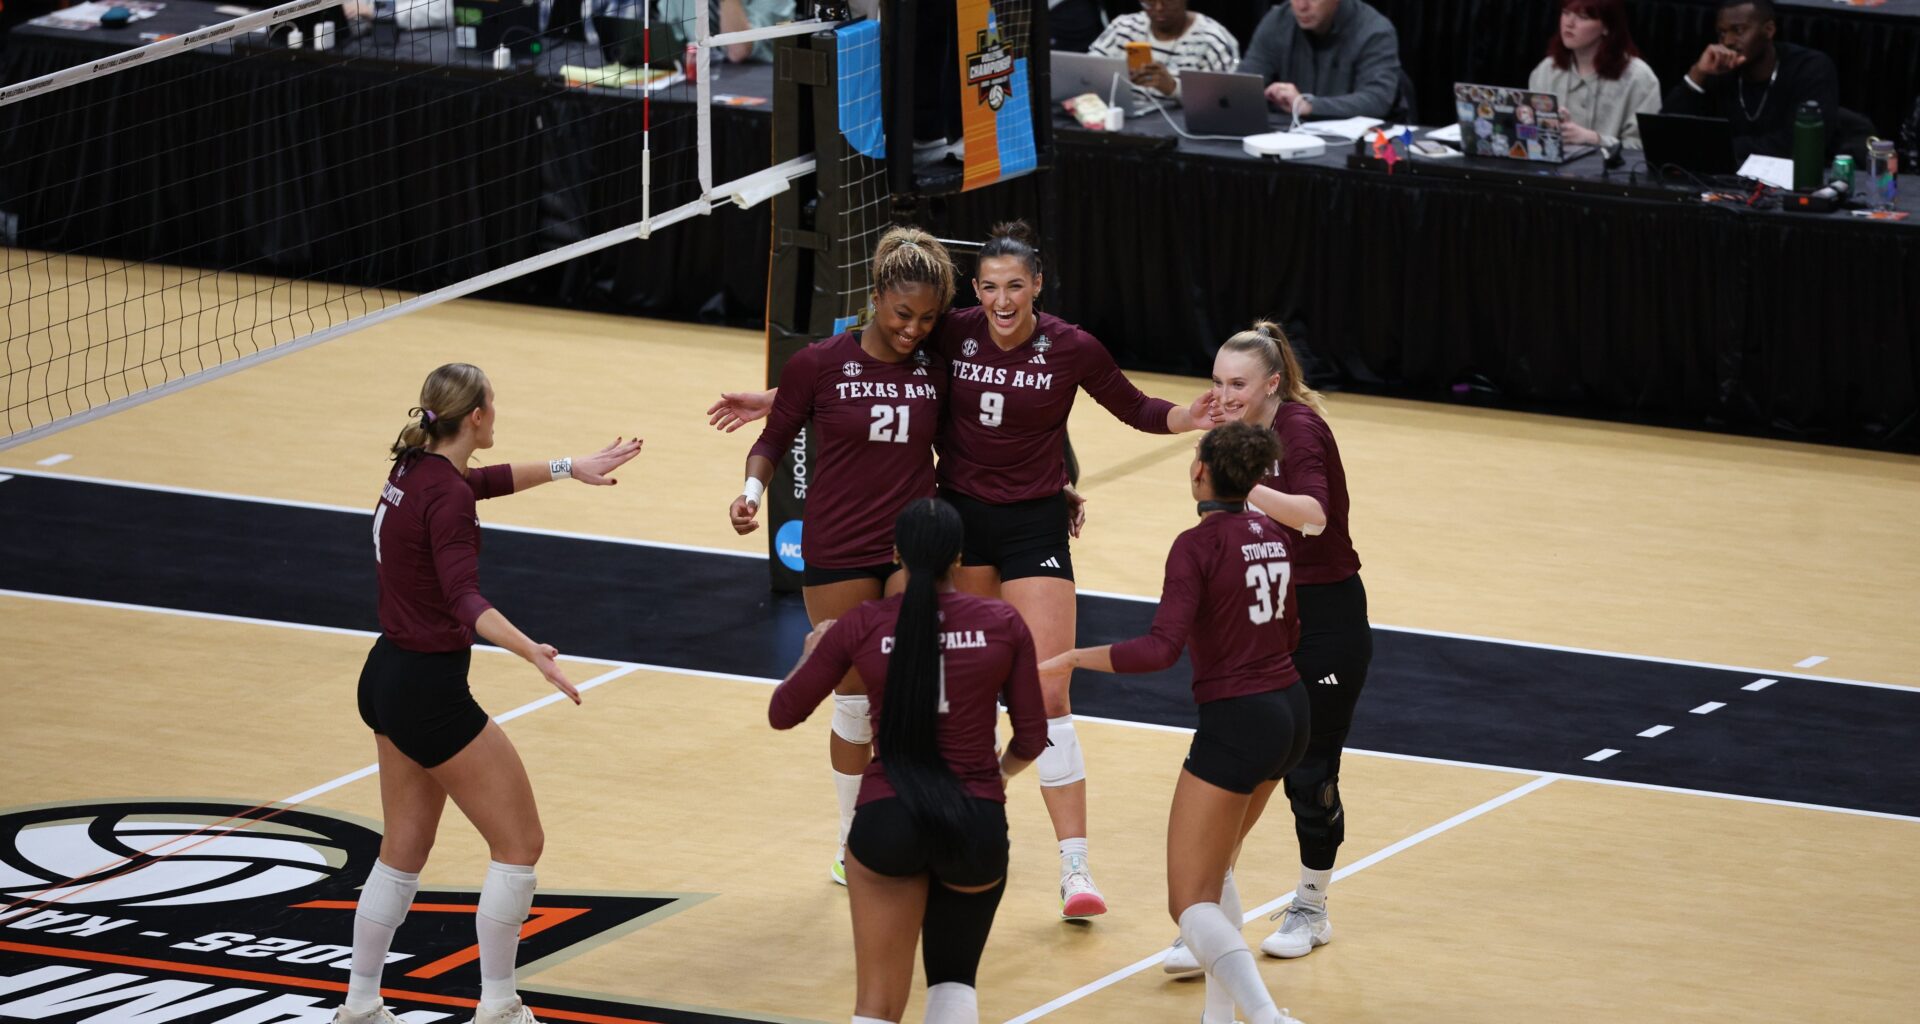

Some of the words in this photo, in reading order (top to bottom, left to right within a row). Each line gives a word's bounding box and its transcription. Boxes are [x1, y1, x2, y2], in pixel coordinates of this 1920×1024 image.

[962, 338, 979, 357] SEC
[843, 361, 863, 377] SEC
[952, 359, 1008, 385] TEXAS
[1011, 370, 1053, 390] A&M
[835, 381, 899, 399] TEXAS
[904, 383, 937, 399] A&M
[979, 391, 1005, 427] 9
[868, 404, 910, 443] 21
[780, 543, 802, 558] NC
[1241, 542, 1287, 562] STOWERS
[1245, 562, 1291, 625] 37
